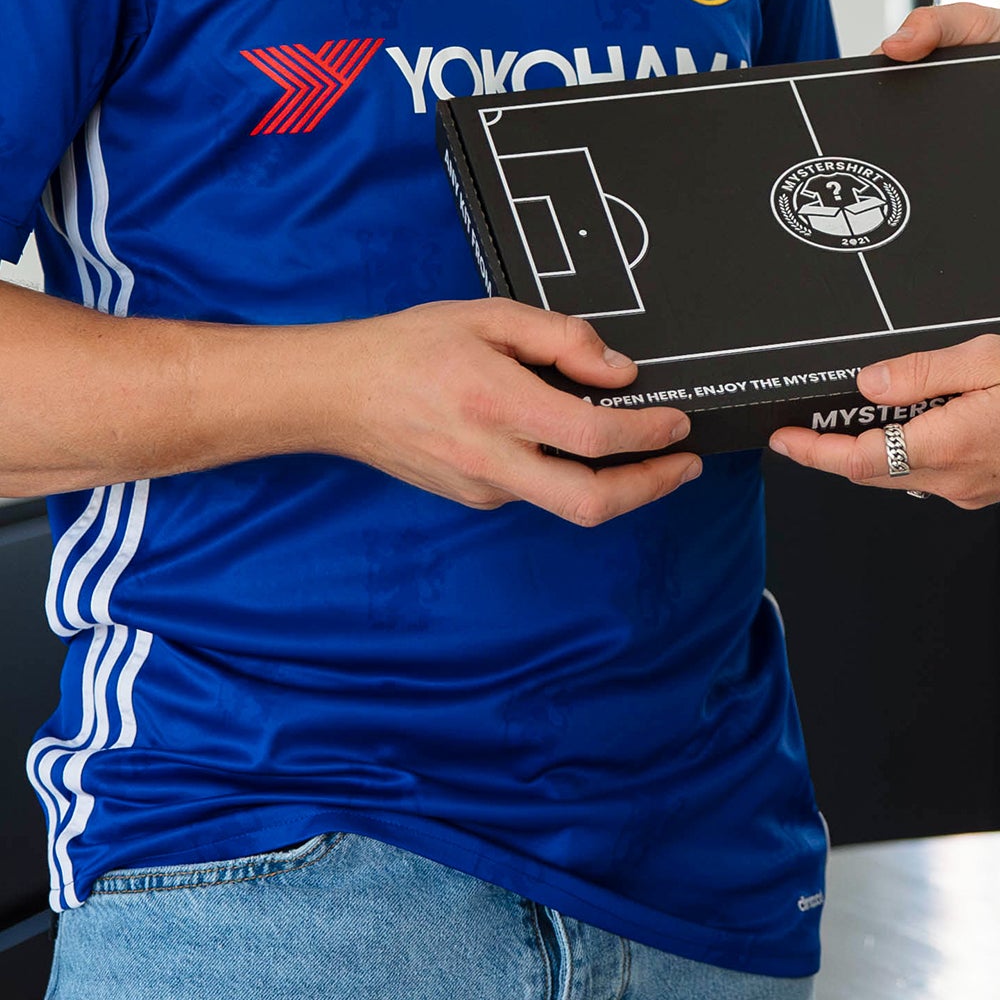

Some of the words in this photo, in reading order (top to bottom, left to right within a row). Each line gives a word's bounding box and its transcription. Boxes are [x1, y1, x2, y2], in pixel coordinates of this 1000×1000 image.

[384, 44, 749, 114] YOKOH
[781, 161, 884, 192] MYSTERSHIRT
[600, 394, 645, 408] OPEN
[647, 388, 693, 403] HERE,
[694, 380, 747, 397] ENJOY
[750, 376, 782, 390] THE
[811, 396, 954, 430] MYSTERS
